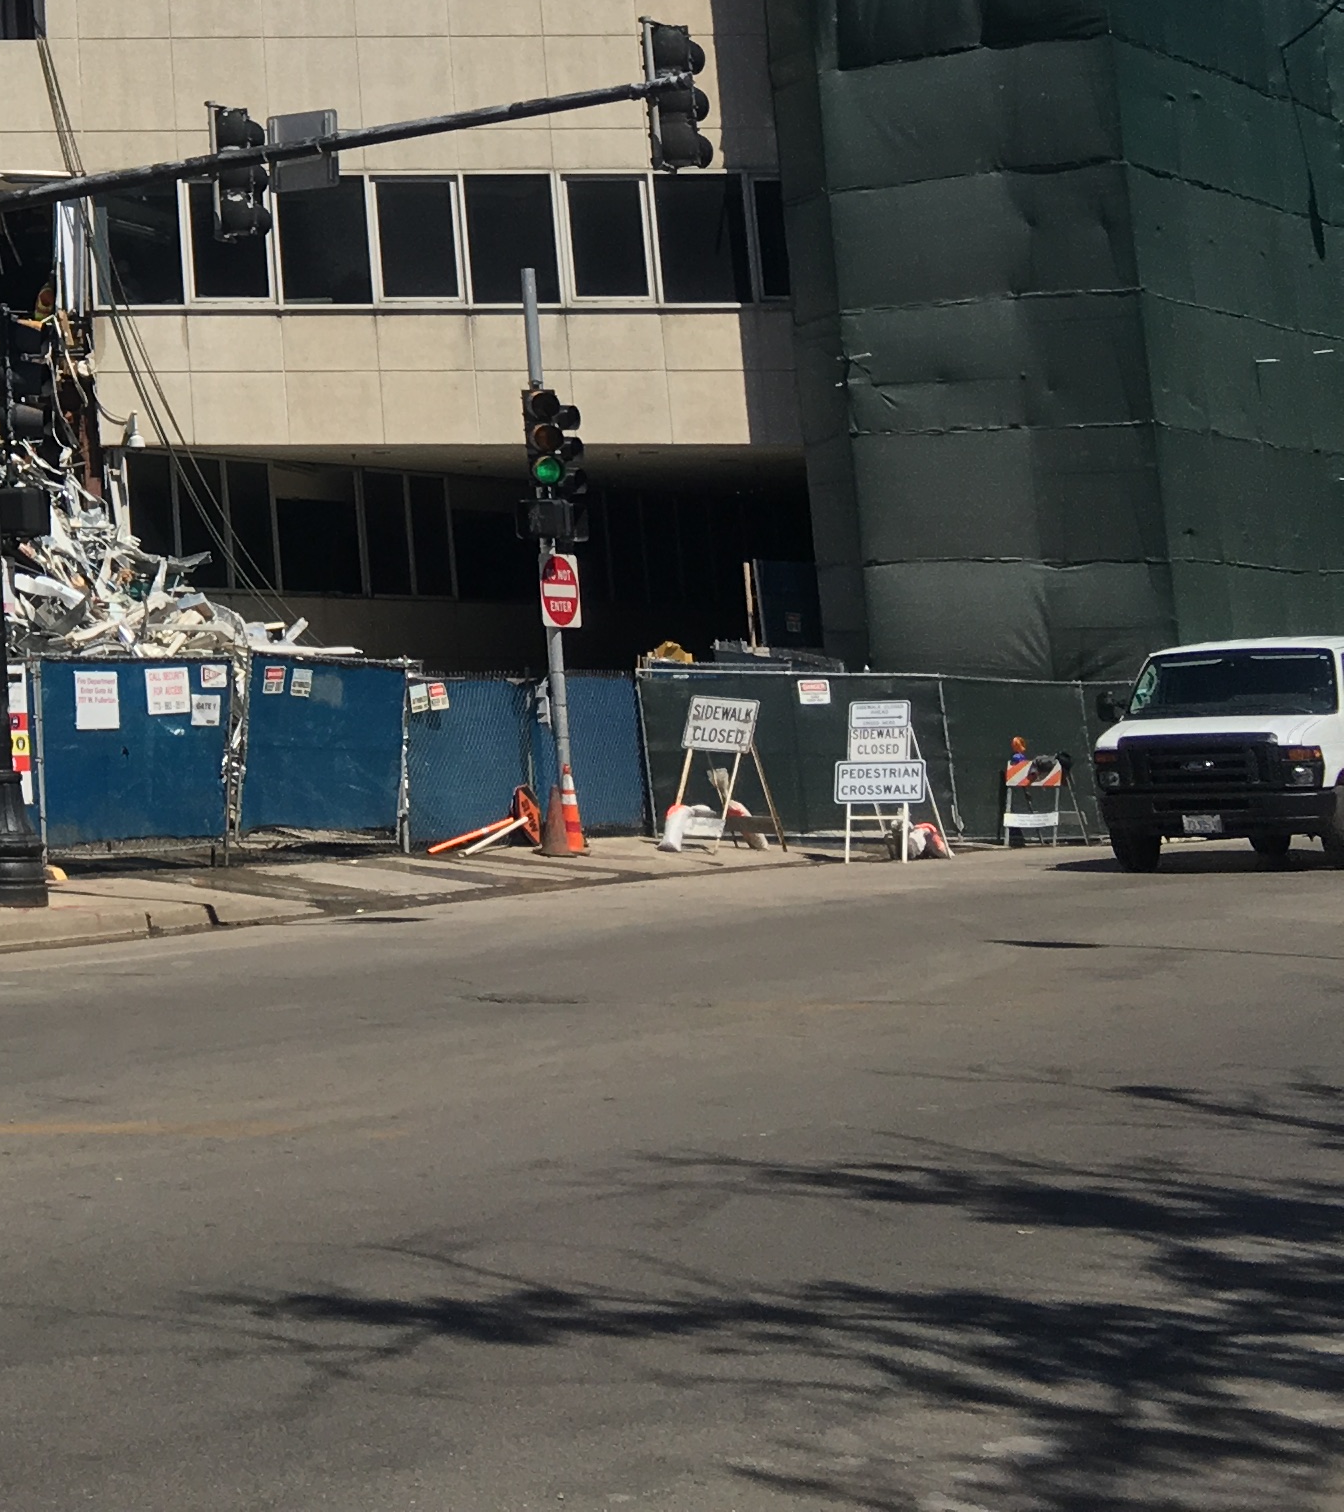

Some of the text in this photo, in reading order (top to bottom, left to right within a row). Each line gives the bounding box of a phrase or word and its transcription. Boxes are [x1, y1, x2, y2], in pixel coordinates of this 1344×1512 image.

[557, 569, 571, 581] NOT
[550, 600, 573, 613] ENTER
[196, 702, 212, 710] GATE
[692, 703, 753, 724] SIDEWALK
[692, 725, 746, 745] CLOSED
[852, 728, 905, 740] SIDEWALK
[857, 744, 900, 755] CLOSED
[841, 768, 920, 779] PEDESTRIAN
[841, 784, 919, 796] CROSSWALK
